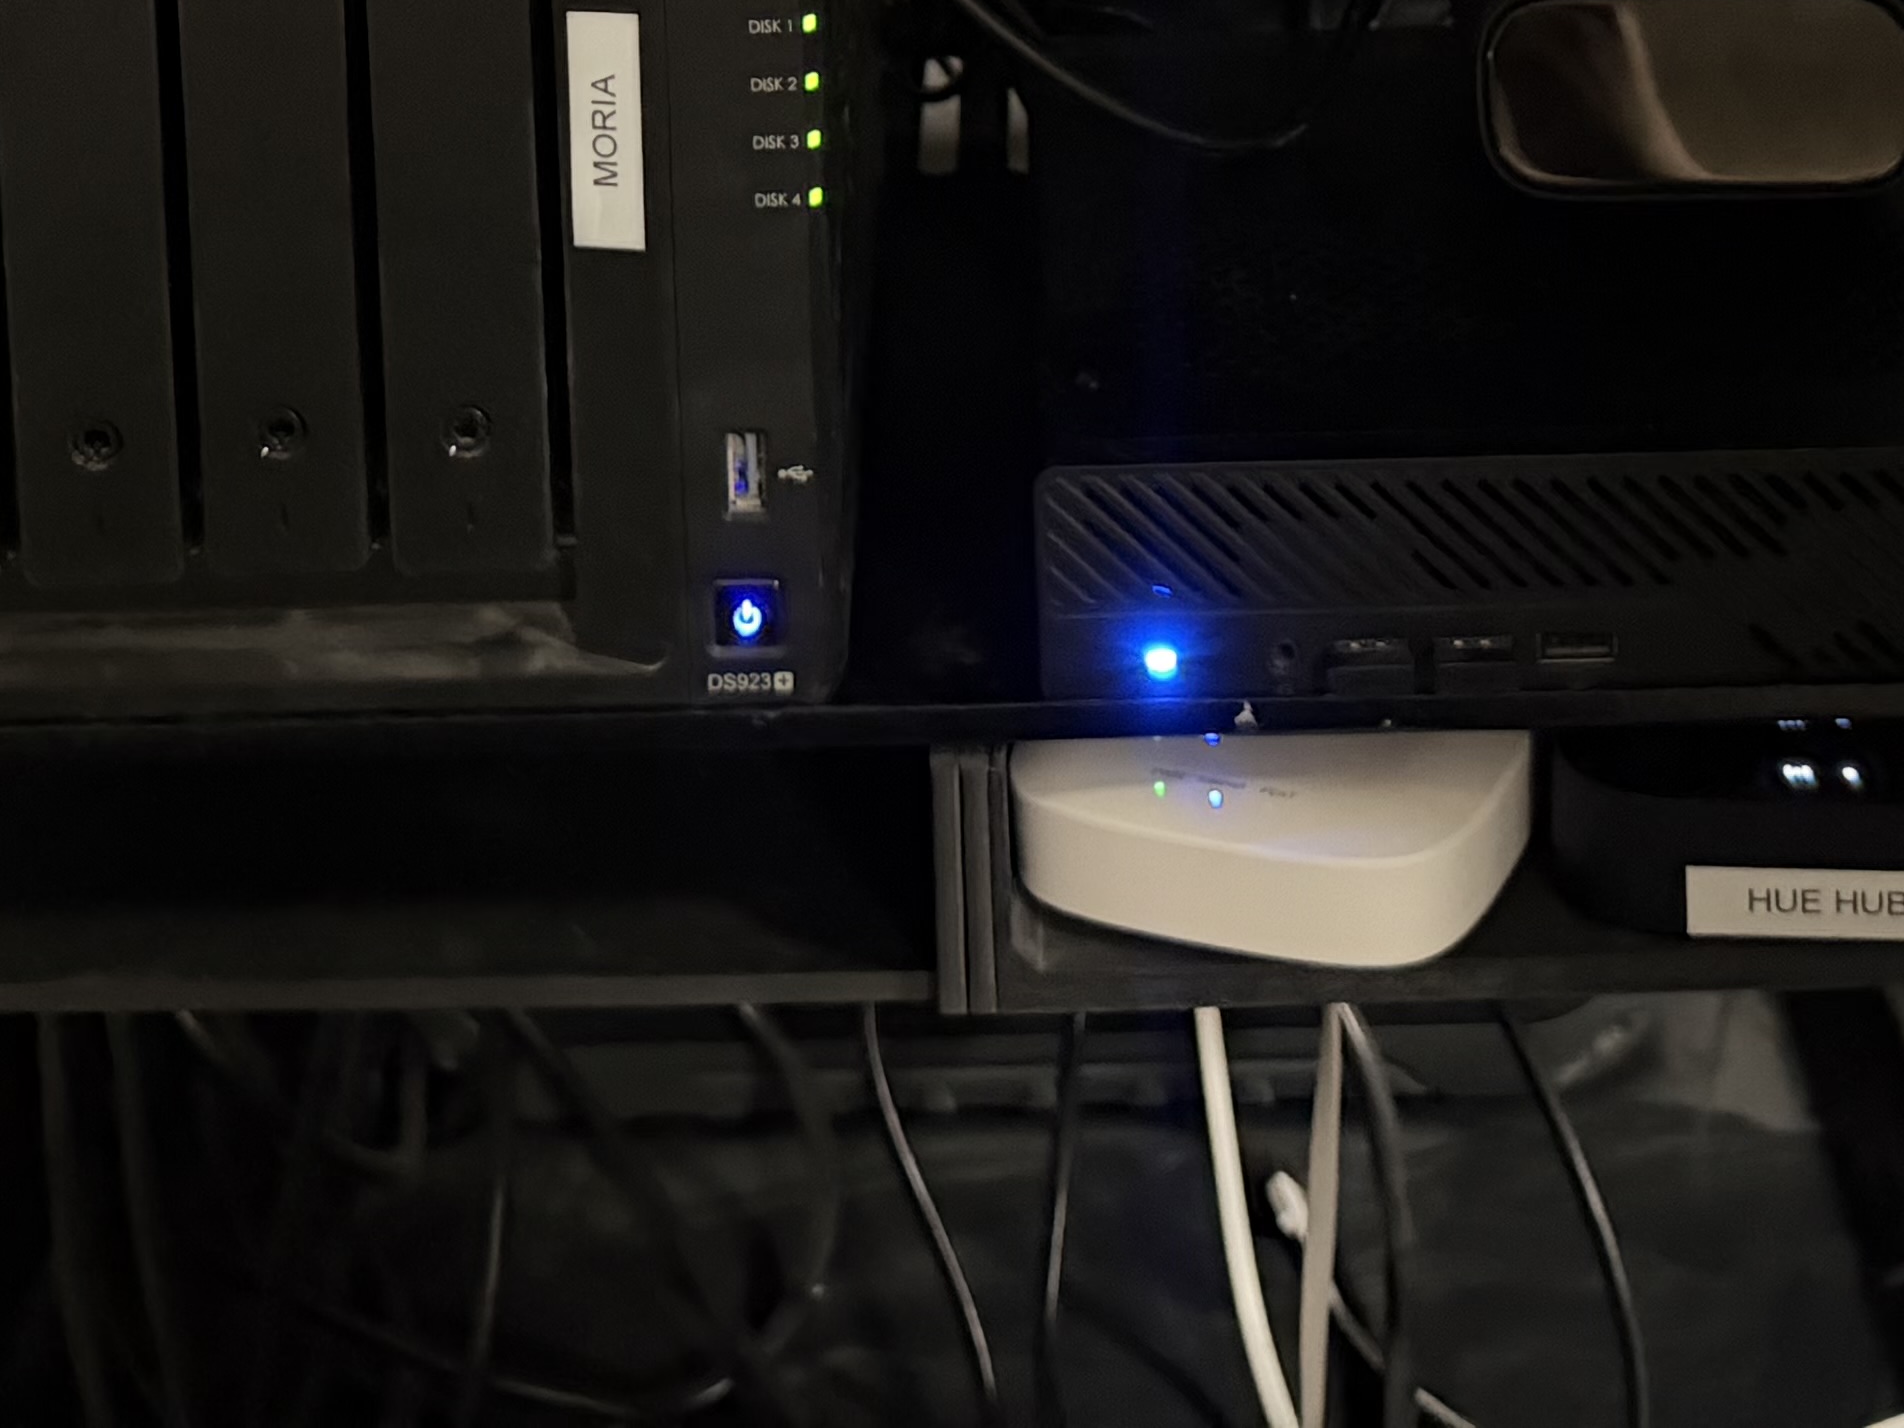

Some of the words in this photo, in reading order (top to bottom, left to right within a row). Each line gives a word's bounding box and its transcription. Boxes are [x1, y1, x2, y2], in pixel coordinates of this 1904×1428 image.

[749, 20, 782, 34] DISK
[788, 19, 793, 33] 1
[751, 77, 784, 92] DISK
[787, 77, 797, 91] 2
[591, 74, 618, 187] MORIA
[753, 135, 786, 150] DISK
[790, 135, 800, 149] 3
[755, 193, 789, 208] DISK
[791, 192, 801, 206] 4
[1747, 887, 1823, 917] HUE
